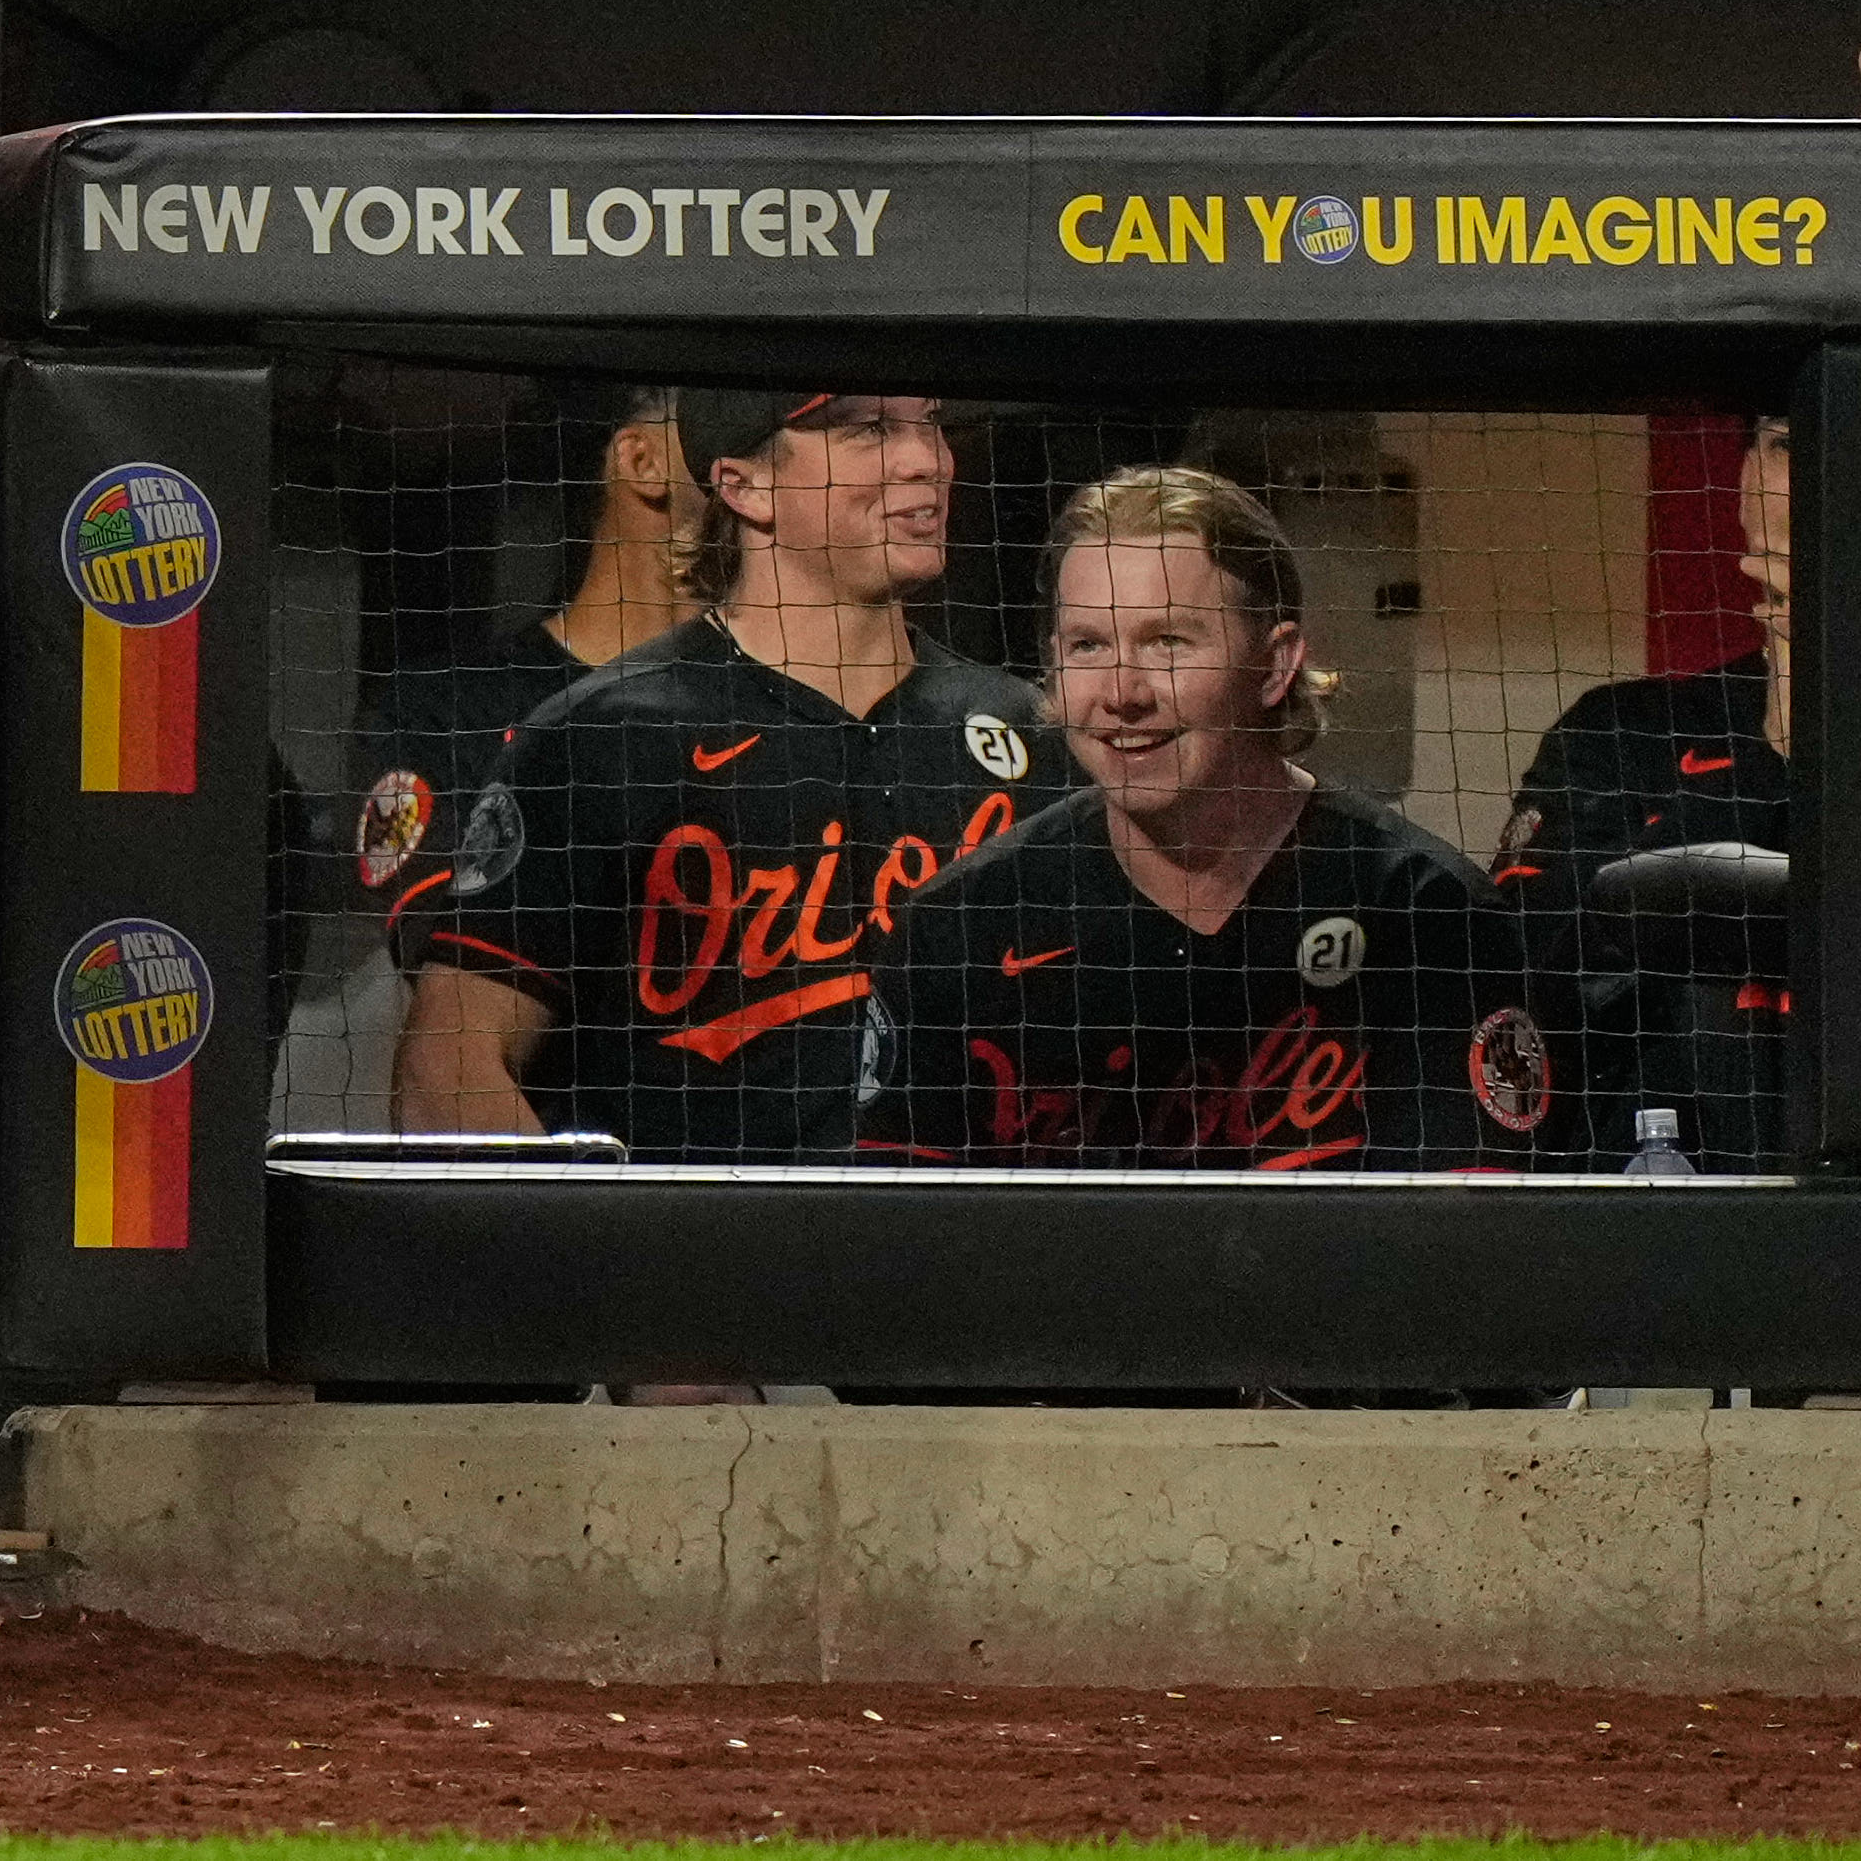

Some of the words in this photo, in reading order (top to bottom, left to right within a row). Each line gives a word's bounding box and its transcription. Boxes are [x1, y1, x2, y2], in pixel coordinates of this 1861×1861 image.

[83, 184, 271, 253] NEW
[293, 186, 525, 256] YORK
[550, 188, 891, 257] LOTTERY
[1059, 195, 1223, 264] CAN
[1437, 195, 1828, 267] IMAGINE?
[128, 476, 185, 506] NEW
[133, 500, 205, 542] YORK
[79, 536, 207, 605] LOTTERY
[976, 727, 1017, 764] 21
[120, 931, 177, 961] NEW
[1311, 932, 1353, 969] 21
[128, 956, 198, 997] YORK
[71, 990, 199, 1061] LOTTERY
